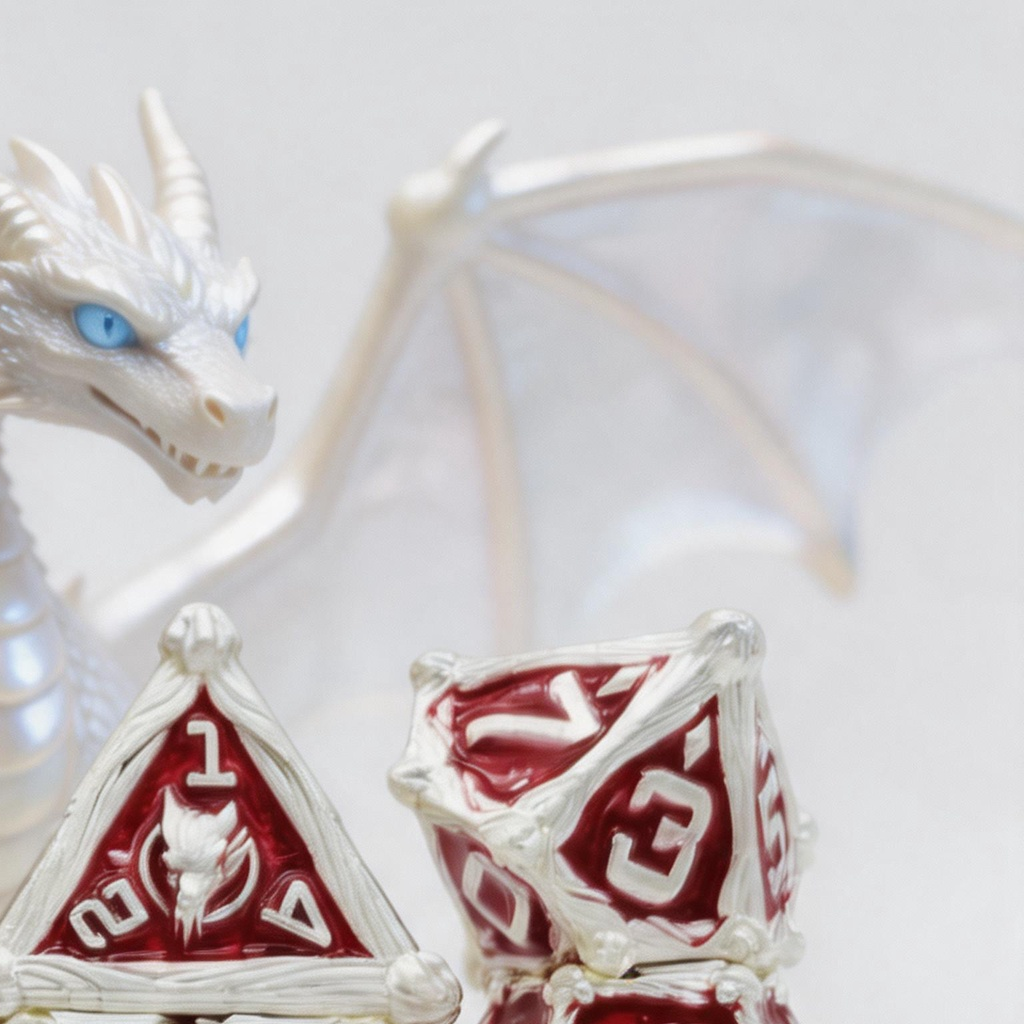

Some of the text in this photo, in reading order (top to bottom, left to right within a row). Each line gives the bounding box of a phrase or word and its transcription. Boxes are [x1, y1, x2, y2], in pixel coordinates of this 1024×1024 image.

[466, 670, 603, 749] 7
[186, 719, 237, 788] 1
[605, 765, 712, 902] 3
[68, 878, 149, 949] 2
